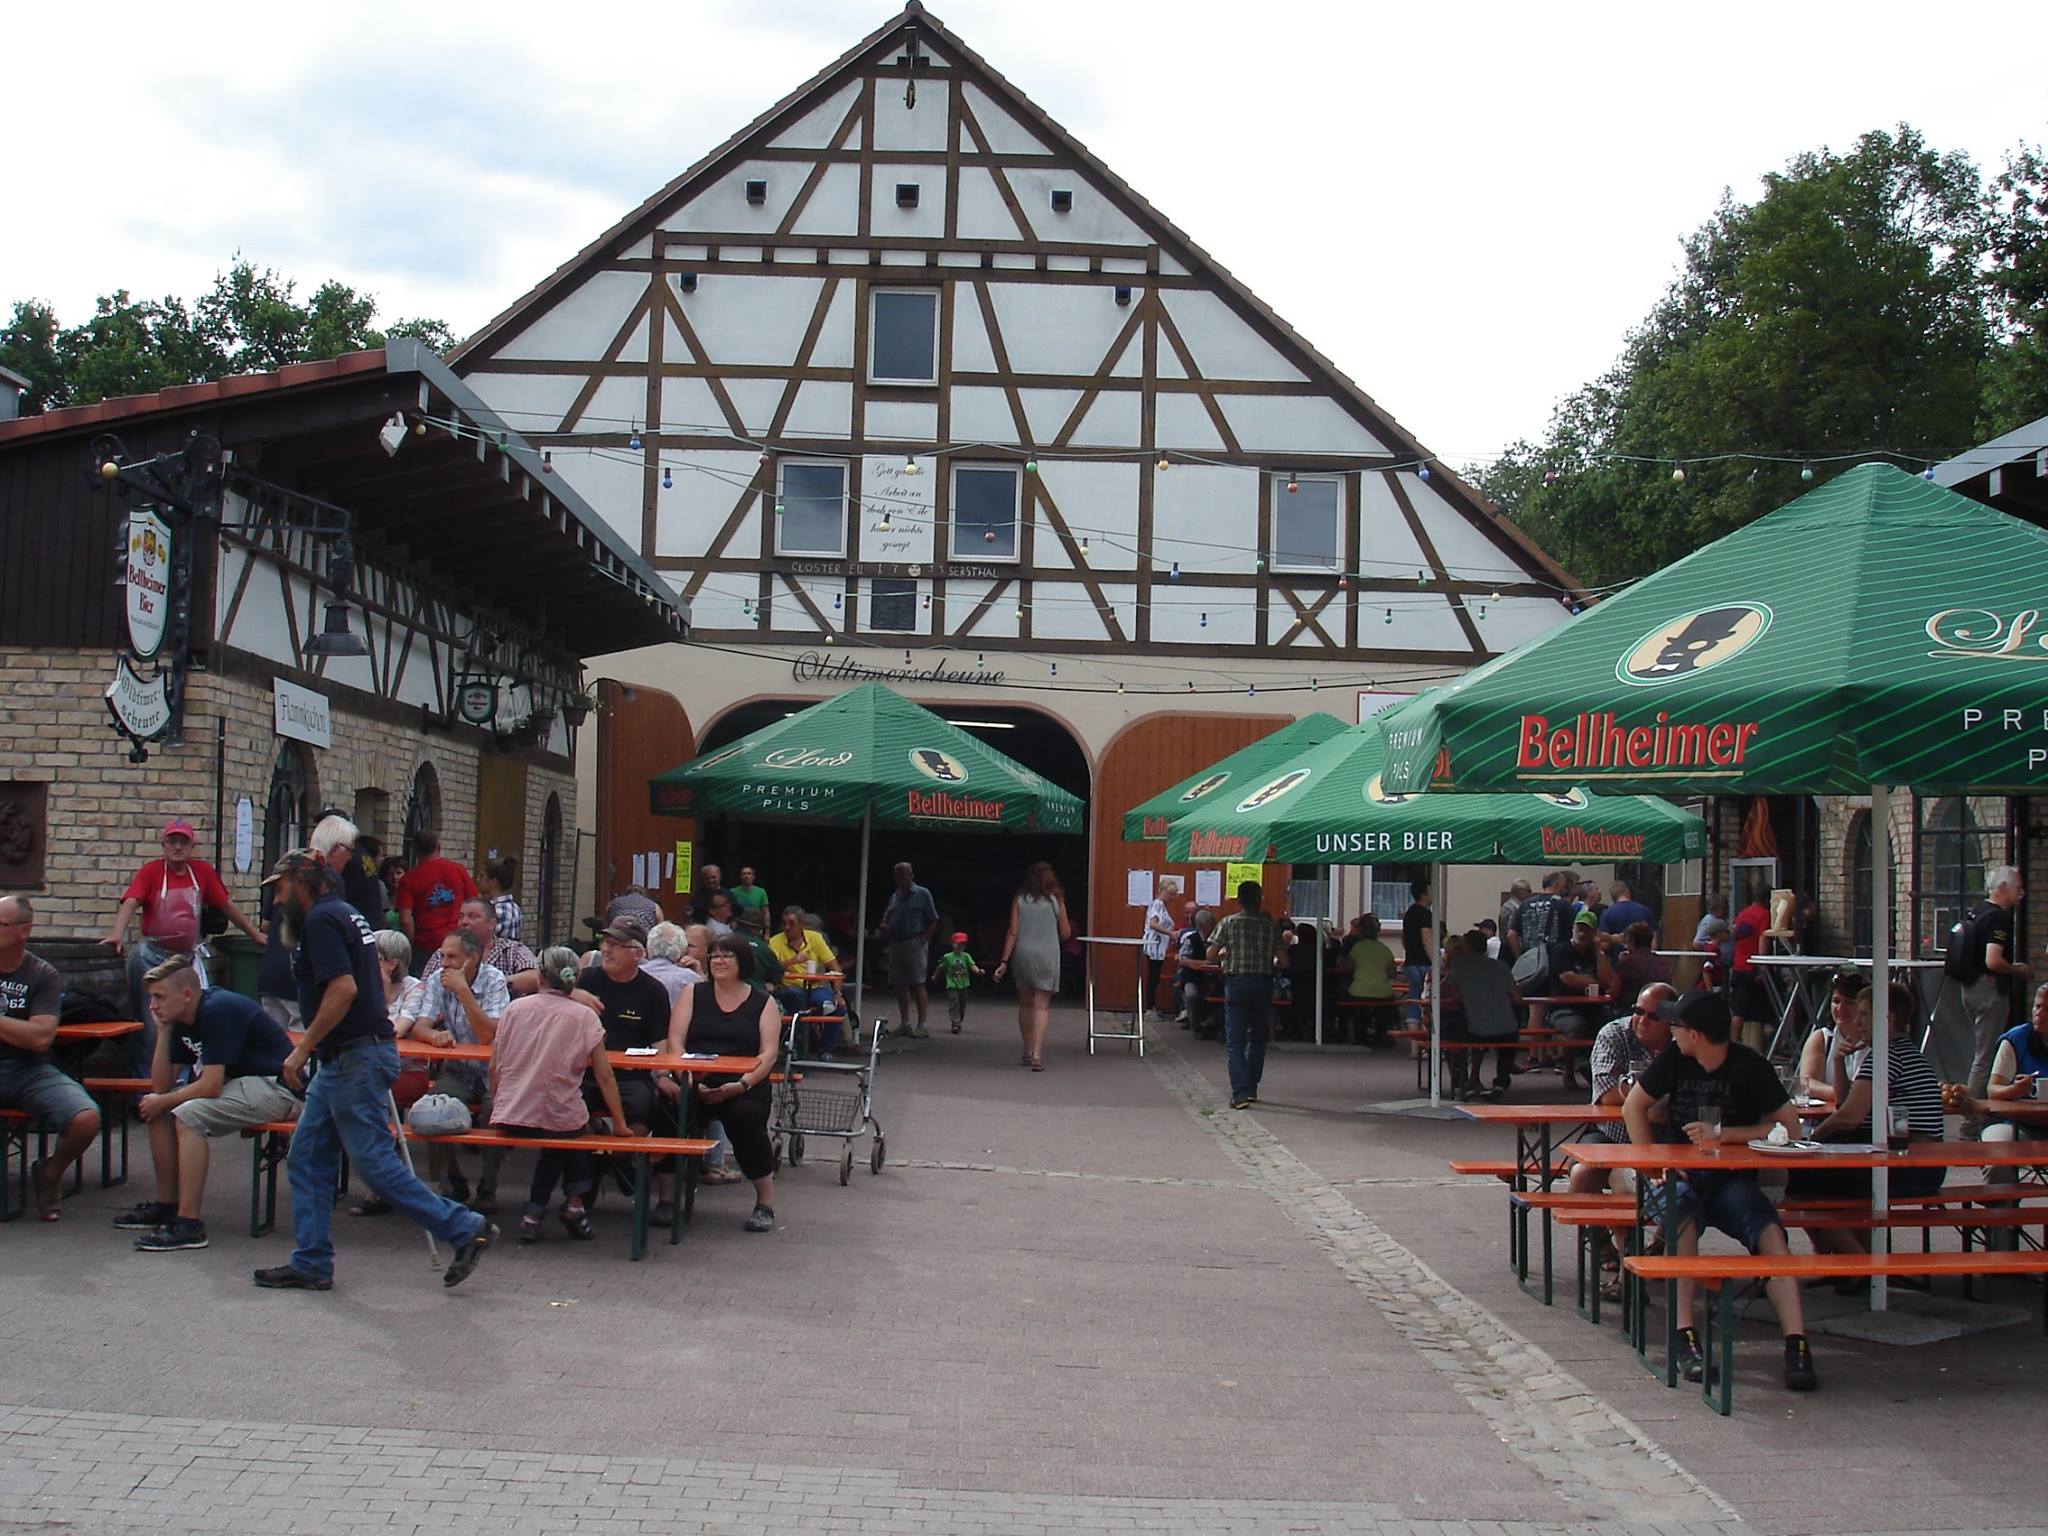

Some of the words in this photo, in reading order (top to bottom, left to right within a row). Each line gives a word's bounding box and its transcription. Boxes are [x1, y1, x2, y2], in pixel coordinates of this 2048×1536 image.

[791, 561, 841, 575] CLOSTER
[792, 650, 1005, 683] Oldtimerscheune
[1963, 708, 2048, 731] PR
[1516, 711, 1759, 768] Bellheimer
[752, 747, 853, 769] Lord
[742, 784, 836, 798] PREMIUM
[762, 799, 810, 811] PILS
[908, 790, 1006, 820] Bellheimer
[1189, 828, 1249, 857] Bellheimer
[1316, 833, 1391, 853] UNSER
[1403, 831, 1453, 851] BIER
[1541, 824, 1645, 855] Bellheimer
